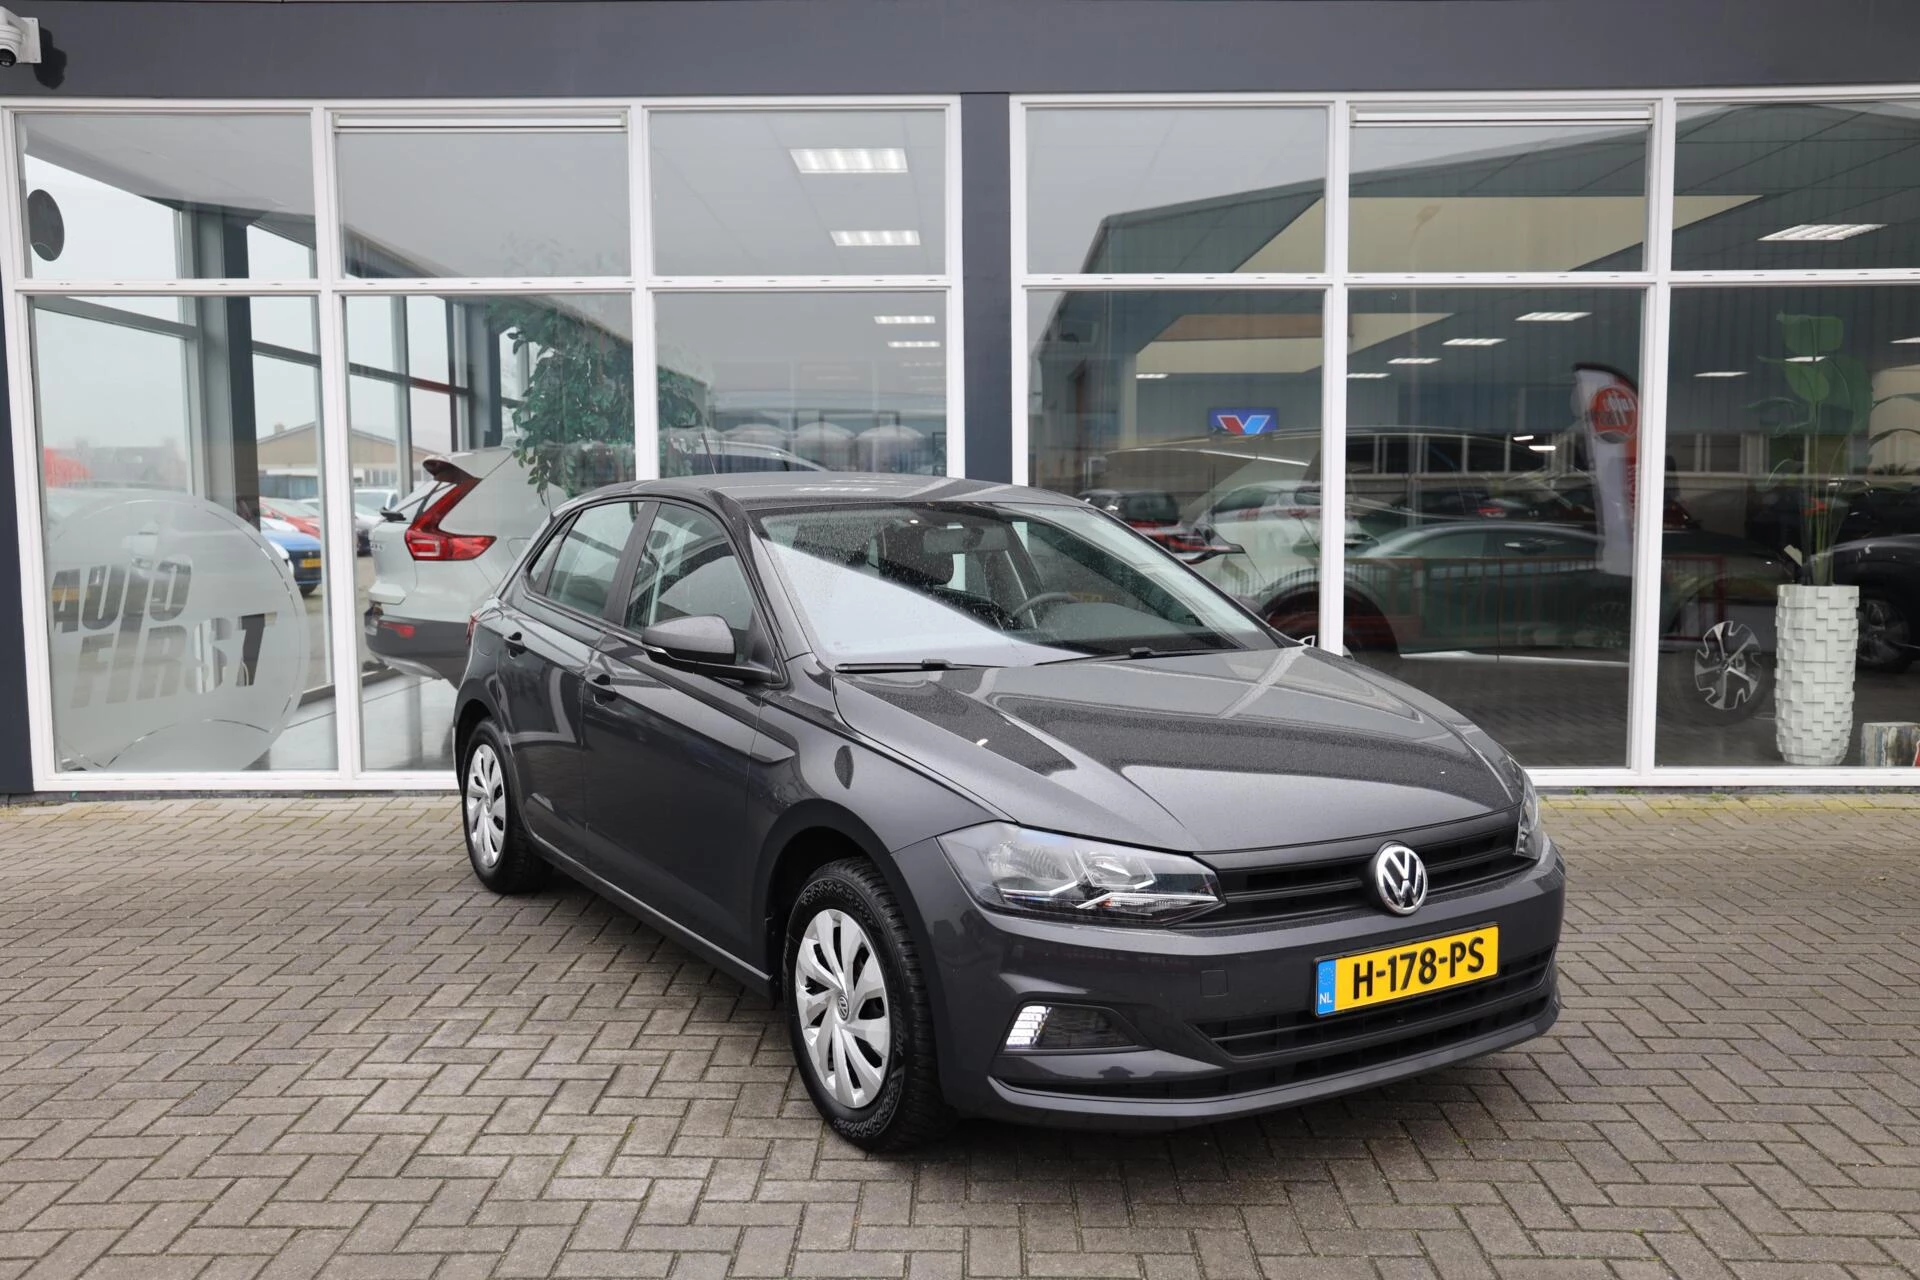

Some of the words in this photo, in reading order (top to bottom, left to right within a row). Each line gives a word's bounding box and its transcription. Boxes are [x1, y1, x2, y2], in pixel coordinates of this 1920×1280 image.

[70, 611, 279, 709] FIRST
[1319, 992, 1333, 1005] NL
[1353, 936, 1484, 1000] H-178-PS
